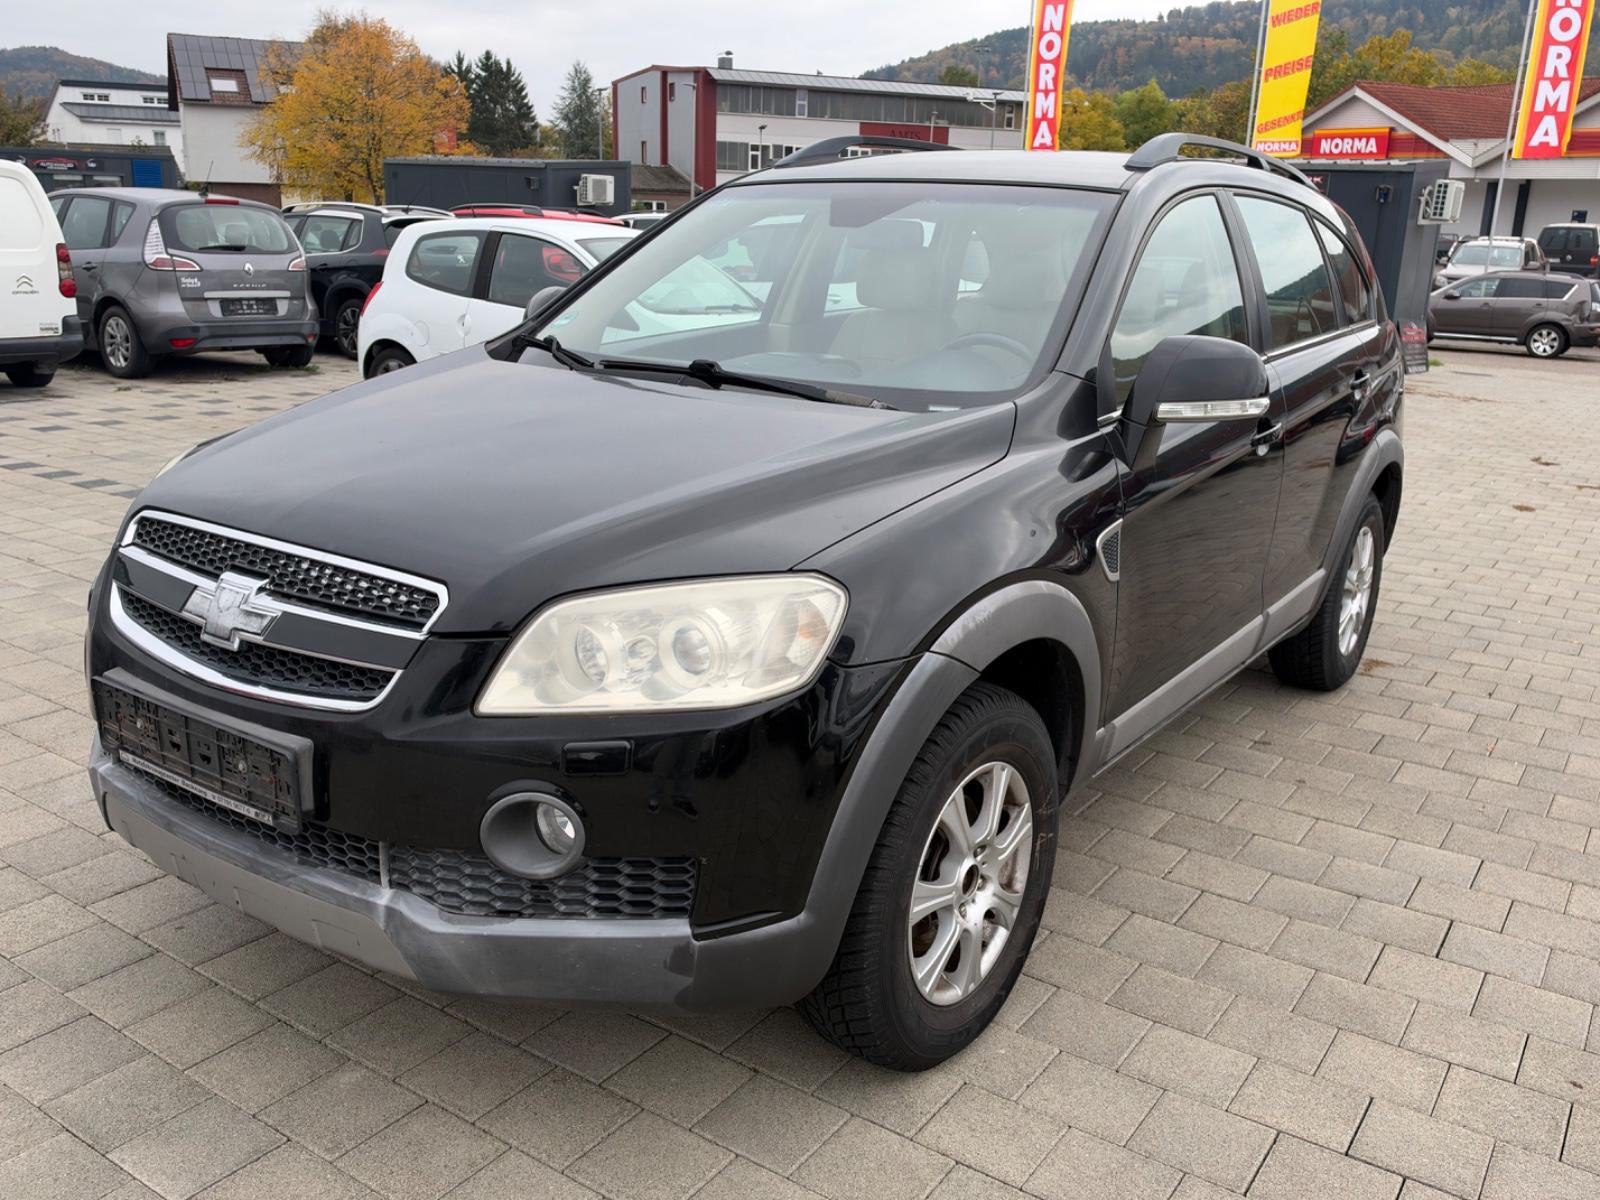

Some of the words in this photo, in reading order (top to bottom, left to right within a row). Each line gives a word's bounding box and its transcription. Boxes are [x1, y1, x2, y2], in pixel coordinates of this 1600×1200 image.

[1270, 2, 1321, 28] WIEDER
[1032, 4, 1065, 148] NORMA
[1264, 54, 1313, 82] PREISE
[1528, 0, 1583, 147] ORMA
[1256, 141, 1298, 153] NORMA
[1320, 137, 1378, 154] NORMA
